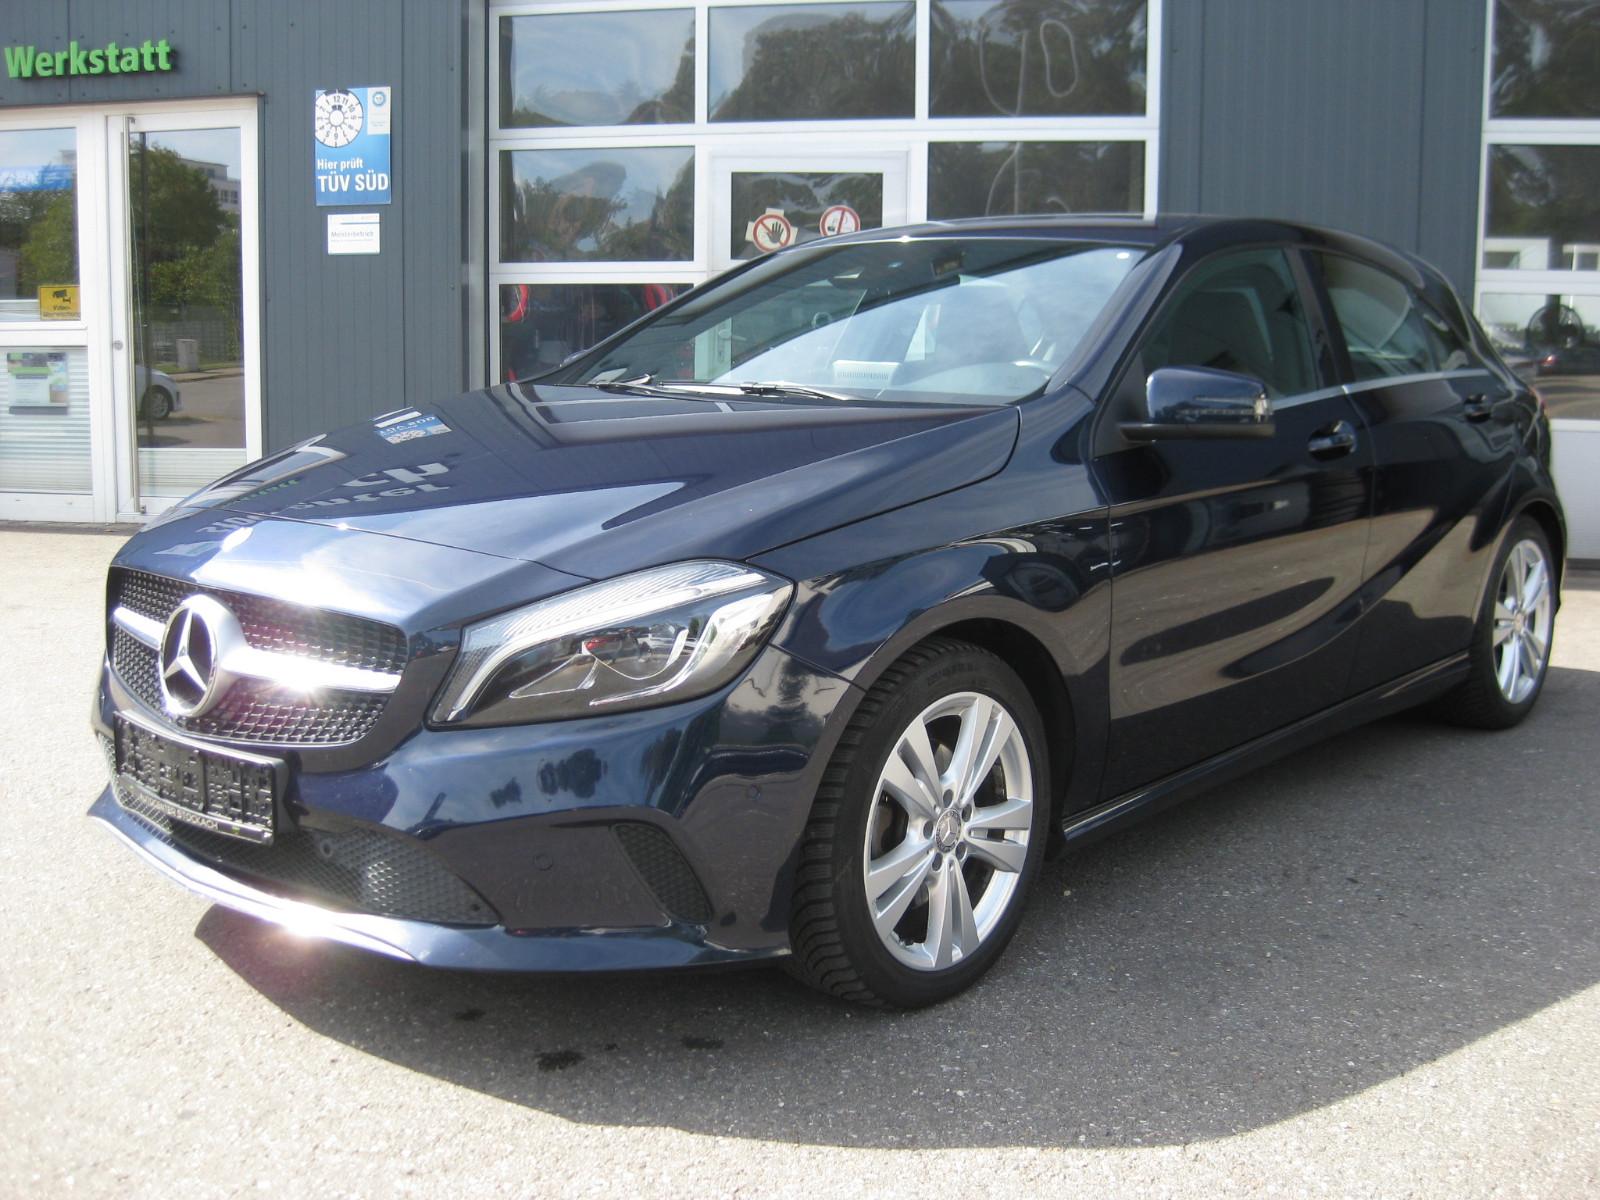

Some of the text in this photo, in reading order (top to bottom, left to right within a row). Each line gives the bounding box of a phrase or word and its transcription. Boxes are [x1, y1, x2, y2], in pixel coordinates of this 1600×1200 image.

[4, 39, 172, 78] Werkstatt
[317, 157, 364, 172] Hier prüft
[317, 169, 389, 192] TÜV SÜD
